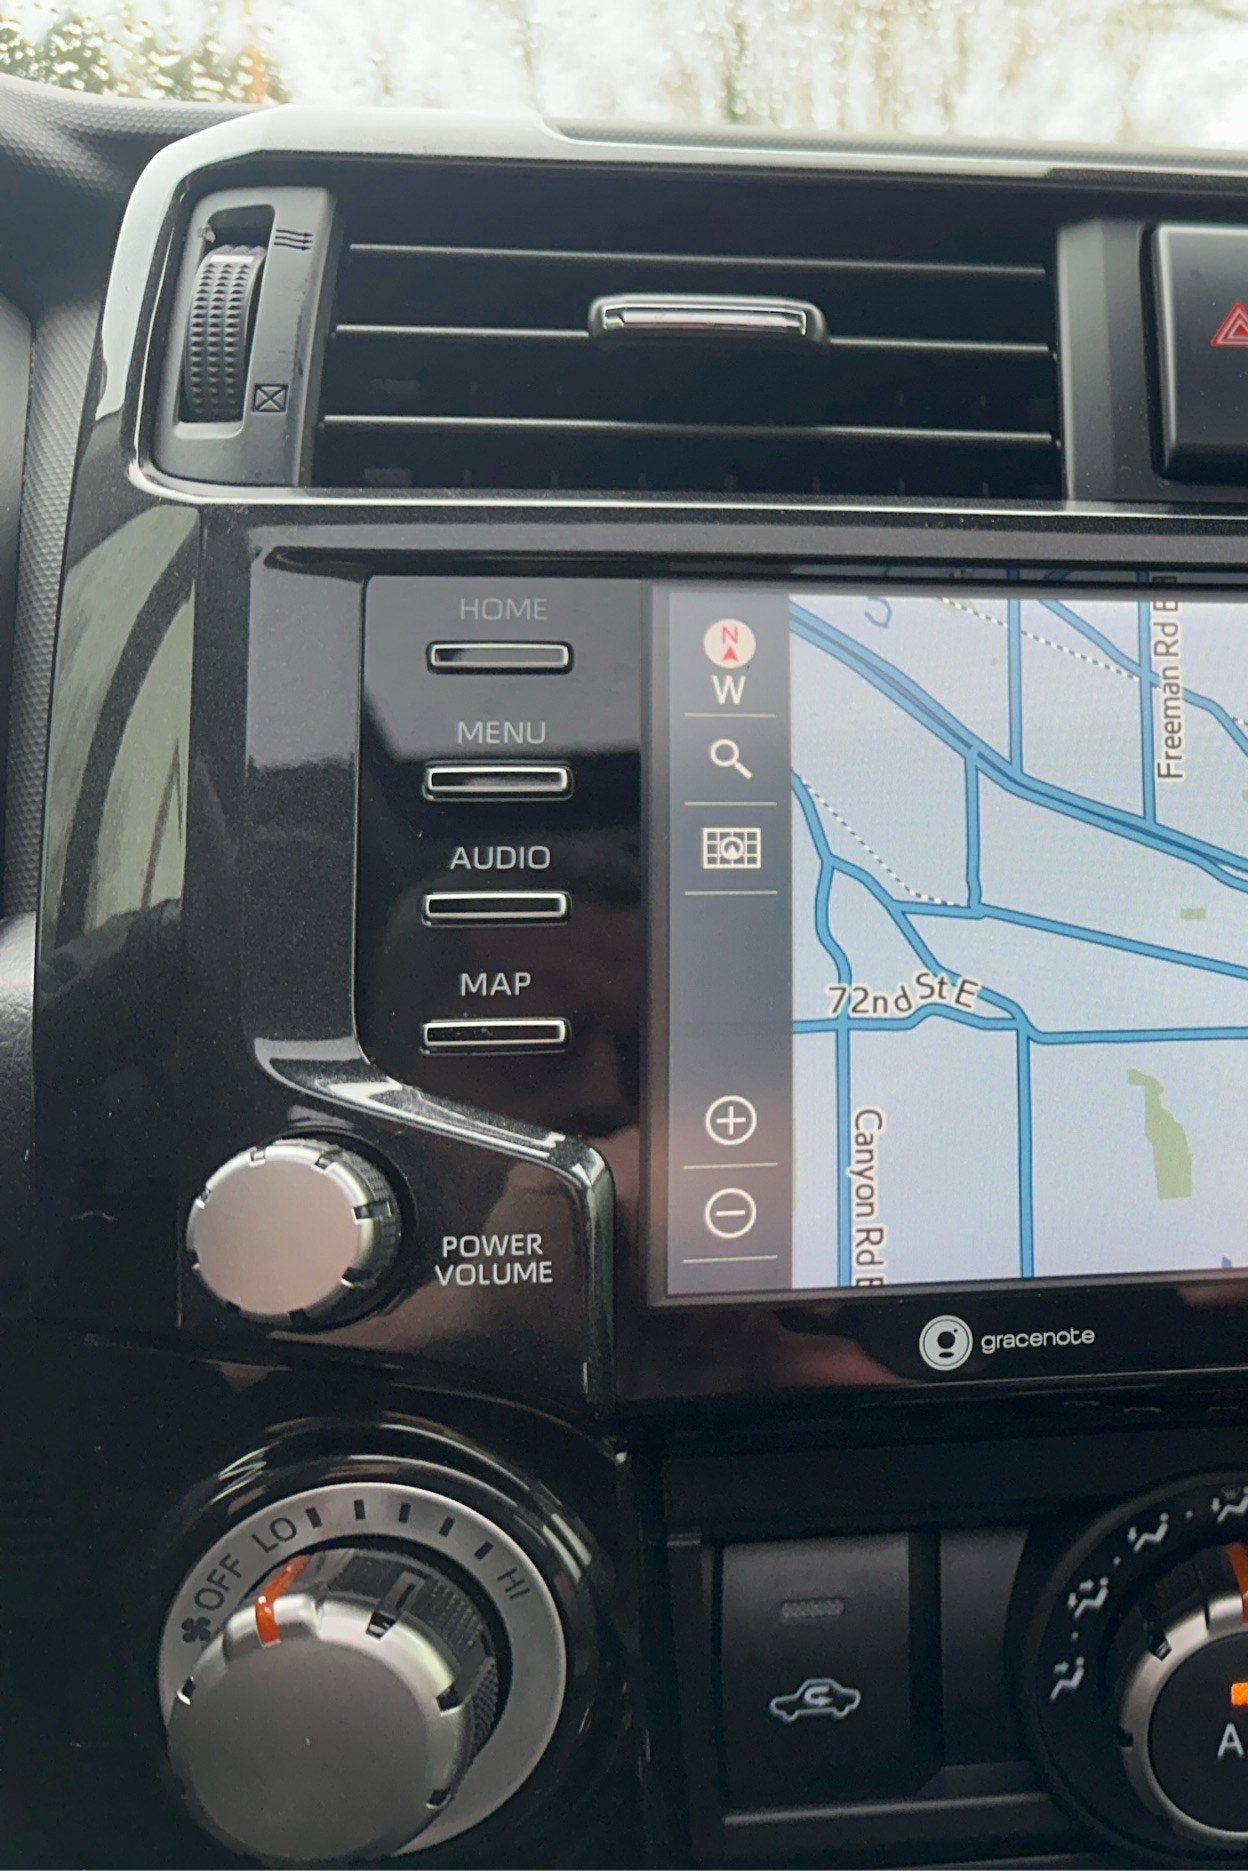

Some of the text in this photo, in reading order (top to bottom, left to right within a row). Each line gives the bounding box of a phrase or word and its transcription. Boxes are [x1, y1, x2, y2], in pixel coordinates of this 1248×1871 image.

[460, 597, 548, 621] HOME
[721, 625, 739, 644] N
[1153, 621, 1179, 657] Rd
[711, 675, 747, 705] W
[457, 721, 547, 745] MENU
[1157, 665, 1183, 779] Freeman
[449, 845, 551, 870] AUDIO
[460, 972, 532, 997] MAP
[828, 972, 979, 1015] 72nd St E
[849, 1108, 883, 1218] Canyon
[442, 1233, 544, 1258] POWER
[855, 1227, 884, 1266] Rd
[434, 1261, 554, 1287] VOLUME
[980, 1327, 1097, 1355] gracenote
[251, 1517, 298, 1554] LO
[193, 1553, 242, 1611] OFF
[497, 1566, 531, 1600] HI
